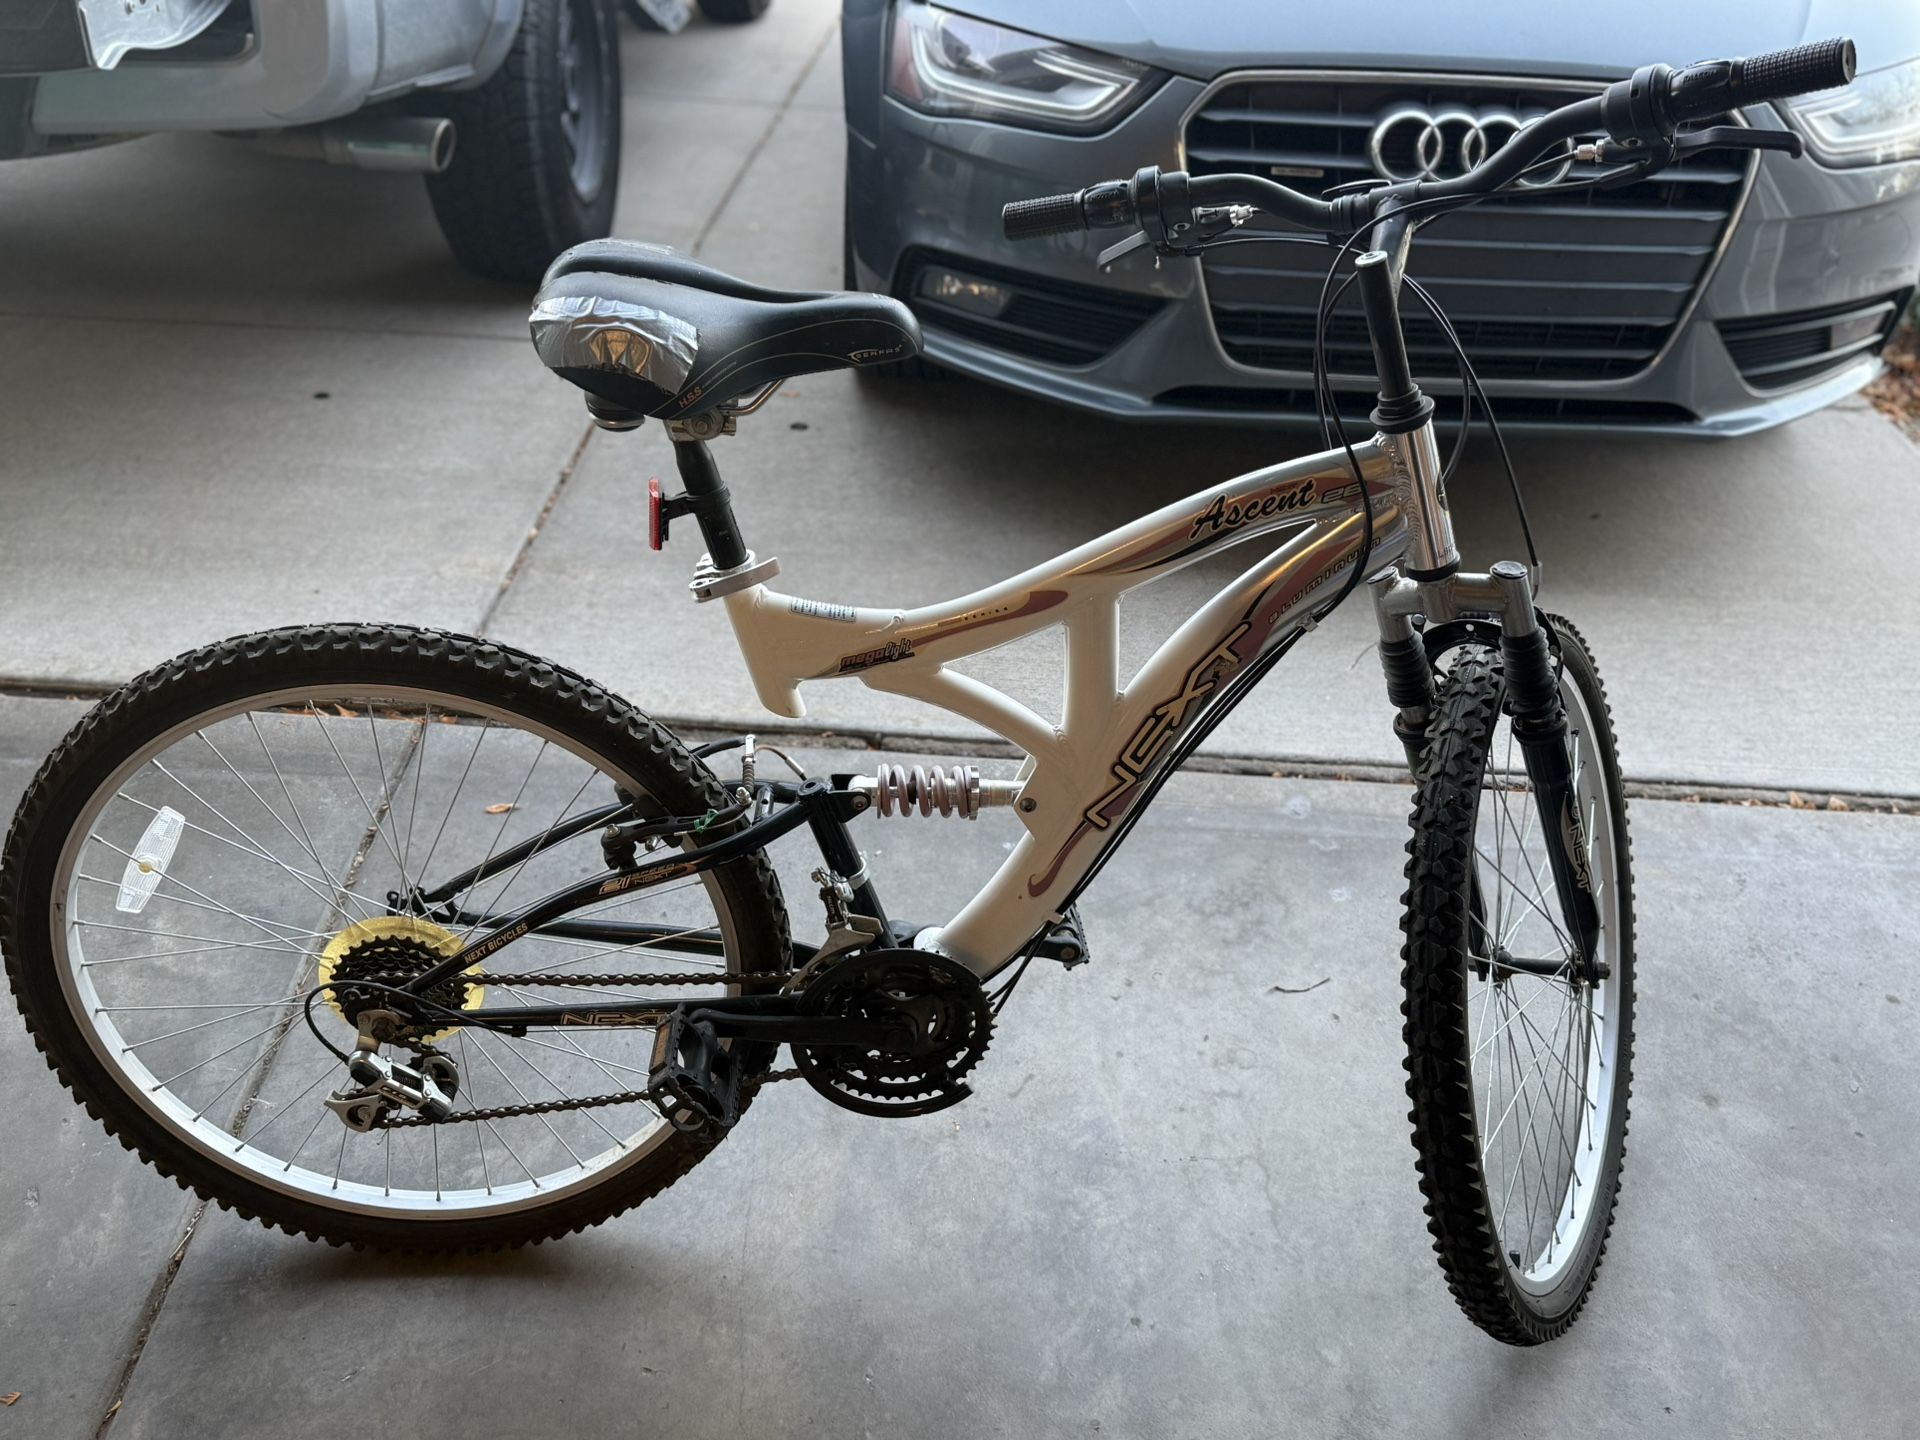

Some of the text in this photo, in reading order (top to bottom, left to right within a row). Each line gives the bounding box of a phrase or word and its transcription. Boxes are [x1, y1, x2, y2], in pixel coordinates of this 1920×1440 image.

[1188, 478, 1318, 541] Ascent
[1084, 621, 1252, 831] NEXT
[1568, 822, 1592, 894] NEXT
[464, 922, 528, 965] NEXT BICYCLES
